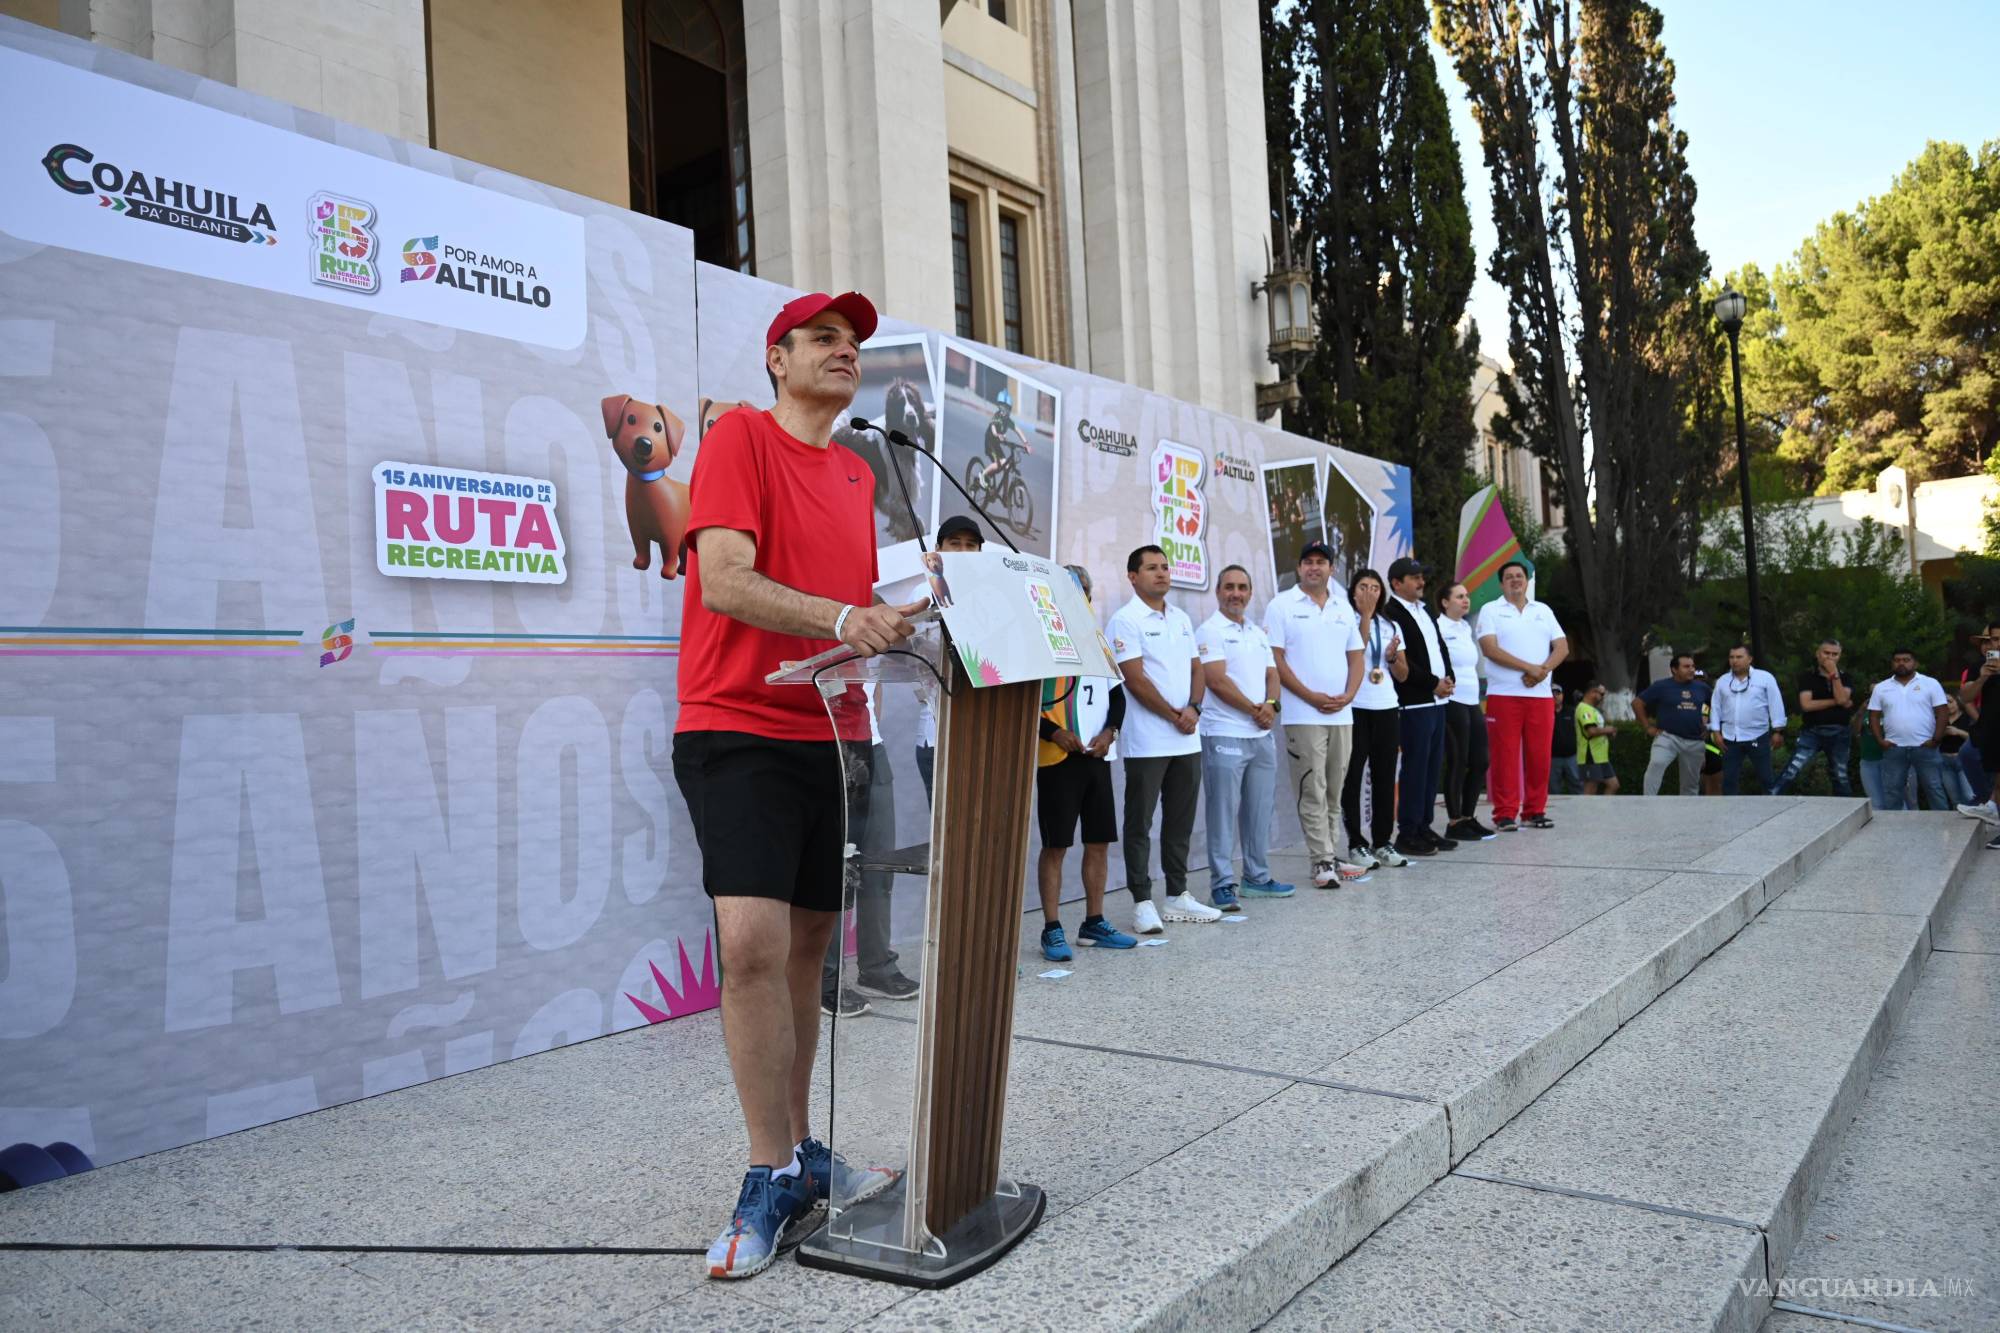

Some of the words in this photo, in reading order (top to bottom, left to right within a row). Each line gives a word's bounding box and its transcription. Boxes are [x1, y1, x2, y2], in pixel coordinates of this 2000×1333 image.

[42, 144, 277, 232] COAHUILA
[168, 211, 241, 239] DELANTE
[318, 226, 369, 244] ANIVERSARIO
[320, 253, 370, 276] RUTA
[444, 246, 477, 264] POR
[479, 252, 523, 275] AMOR
[527, 265, 538, 280] A
[1078, 419, 1138, 449] COAHUILA
[382, 469, 406, 486] 15
[409, 472, 534, 499] ANIVERSARIO
[538, 484, 551, 494] DE
[538, 493, 551, 503] LA
[385, 489, 557, 551] RUTA
[387, 543, 558, 574] RECREATIVA
[1161, 537, 1201, 567] RUTA
[1083, 685, 1093, 706] 7
